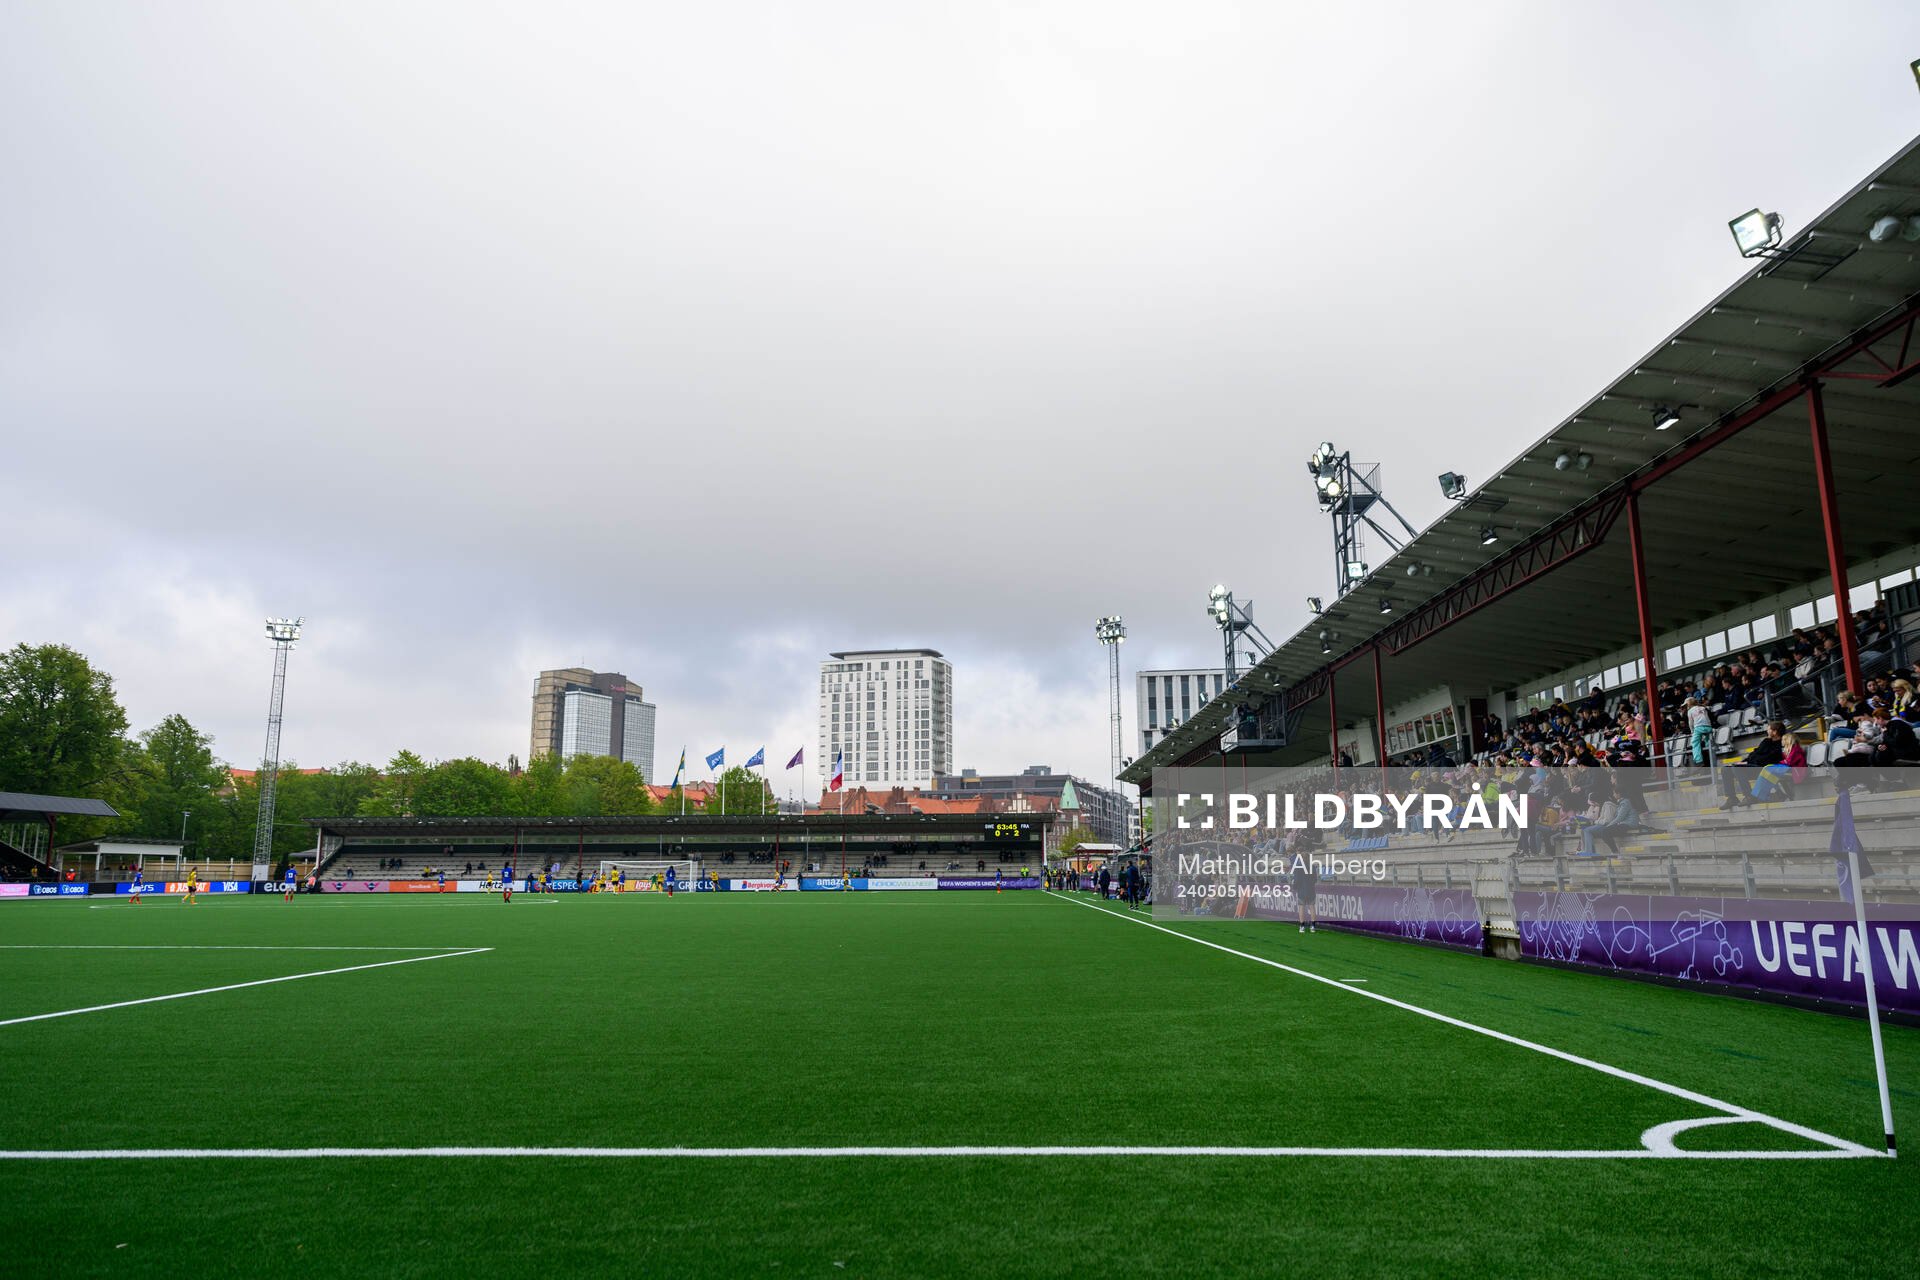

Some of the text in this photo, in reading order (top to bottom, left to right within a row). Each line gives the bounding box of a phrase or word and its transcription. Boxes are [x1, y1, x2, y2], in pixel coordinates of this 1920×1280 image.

[222, 881, 239, 892] VISA
[548, 881, 584, 890] ESPEC
[1340, 894, 1364, 921] 2024
[1751, 920, 1869, 982] UEFA
